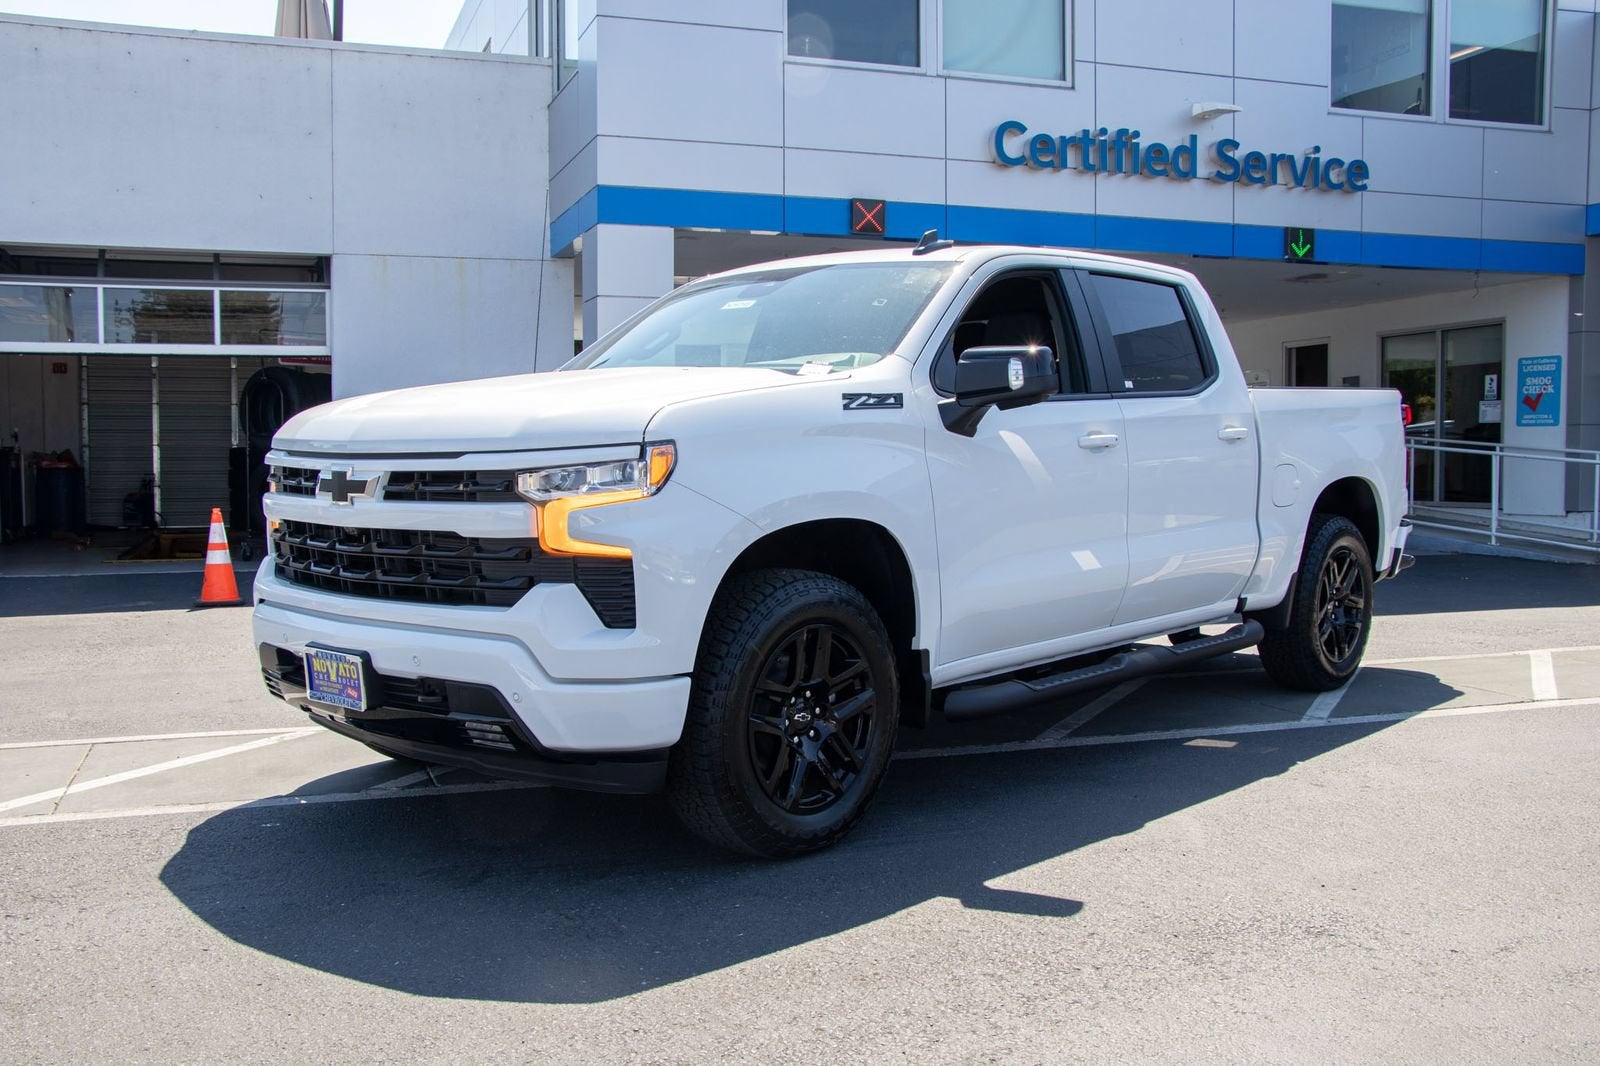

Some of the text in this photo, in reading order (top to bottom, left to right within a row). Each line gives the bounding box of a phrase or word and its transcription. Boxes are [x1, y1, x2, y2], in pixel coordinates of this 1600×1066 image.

[994, 120, 1370, 192] Certified Service
[1522, 364, 1556, 372] LICENSED
[1526, 376, 1552, 386] SMOG
[1522, 385, 1554, 394] CHECK
[842, 393, 903, 410] Z71
[313, 658, 357, 682] NOVATO
